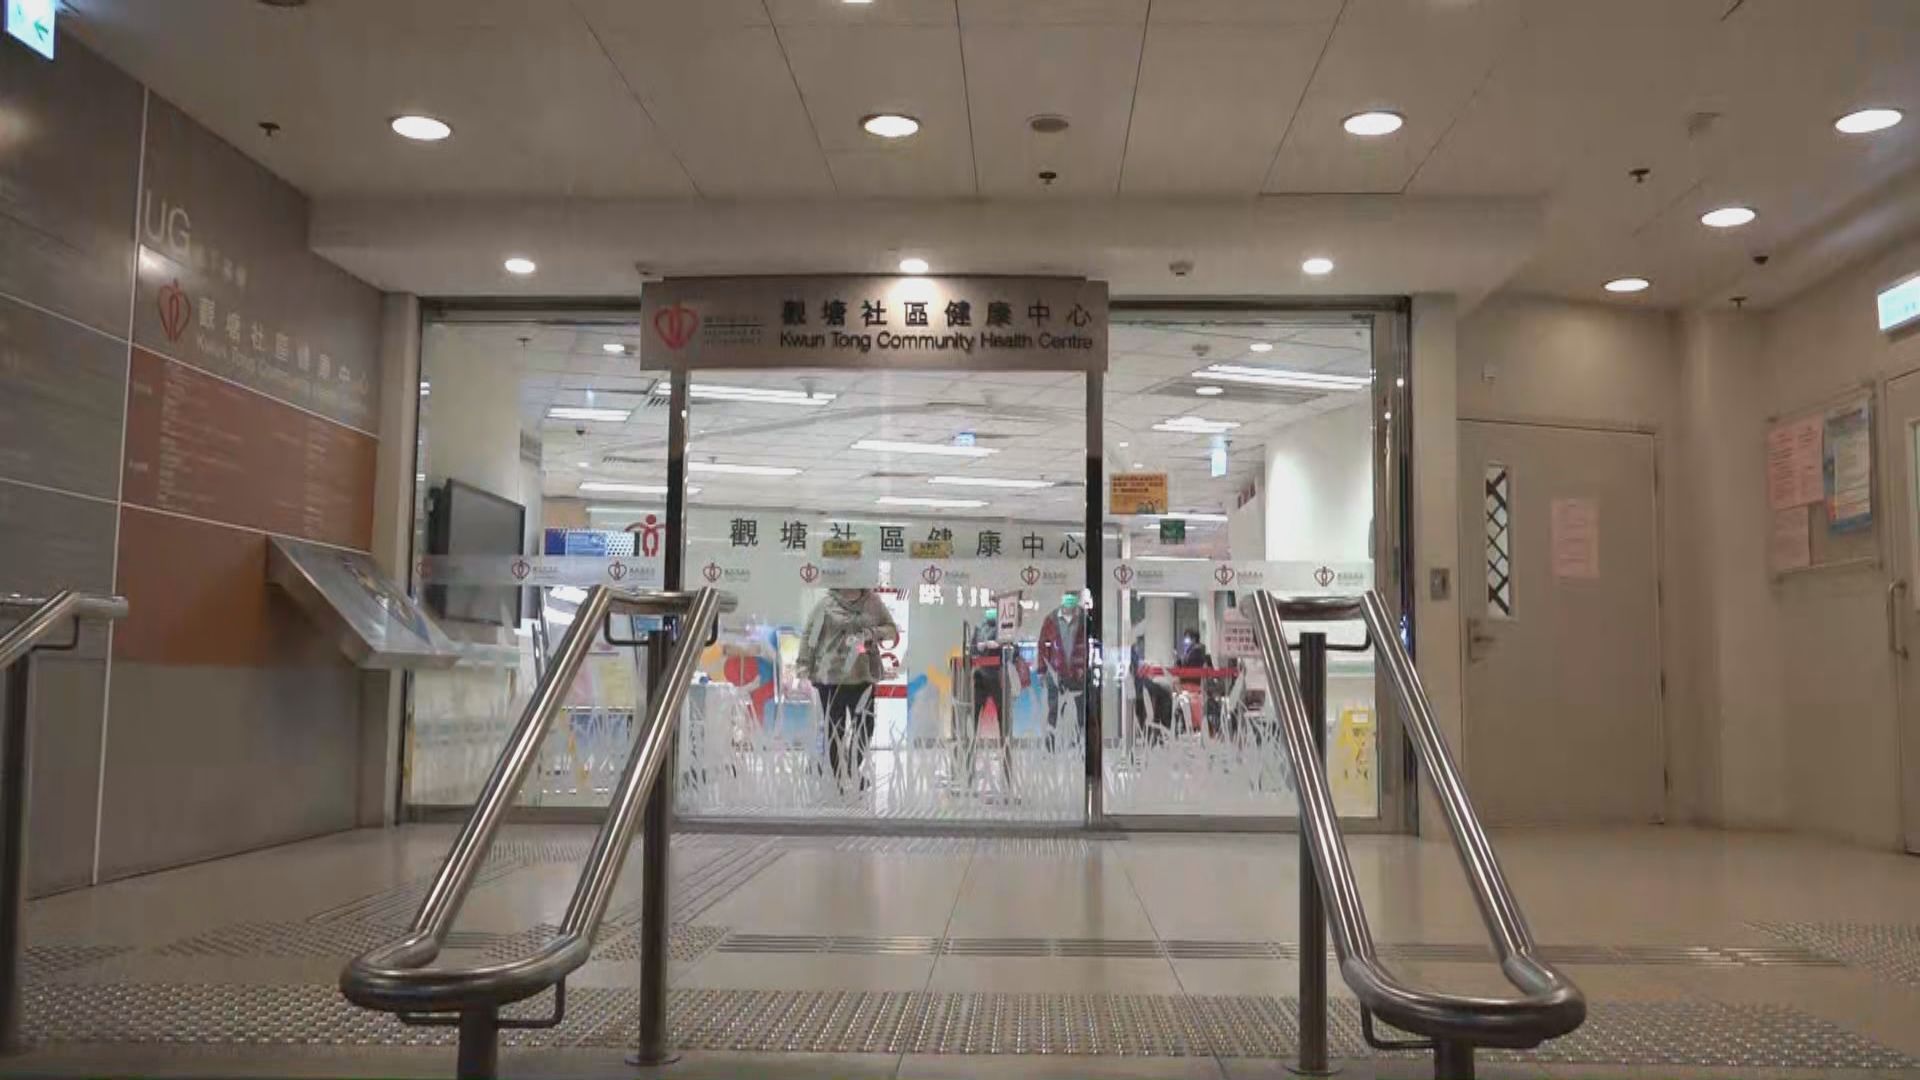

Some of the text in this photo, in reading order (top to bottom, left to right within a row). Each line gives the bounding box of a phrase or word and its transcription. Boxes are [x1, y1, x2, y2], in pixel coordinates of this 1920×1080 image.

[146, 190, 191, 252] UG
[782, 299, 1093, 328] 觀塘社區健康中心
[780, 331, 825, 348] Kwun
[831, 331, 871, 353] Tong
[876, 330, 974, 354] Community
[981, 332, 1033, 348] Health
[1039, 333, 1093, 350] Centre
